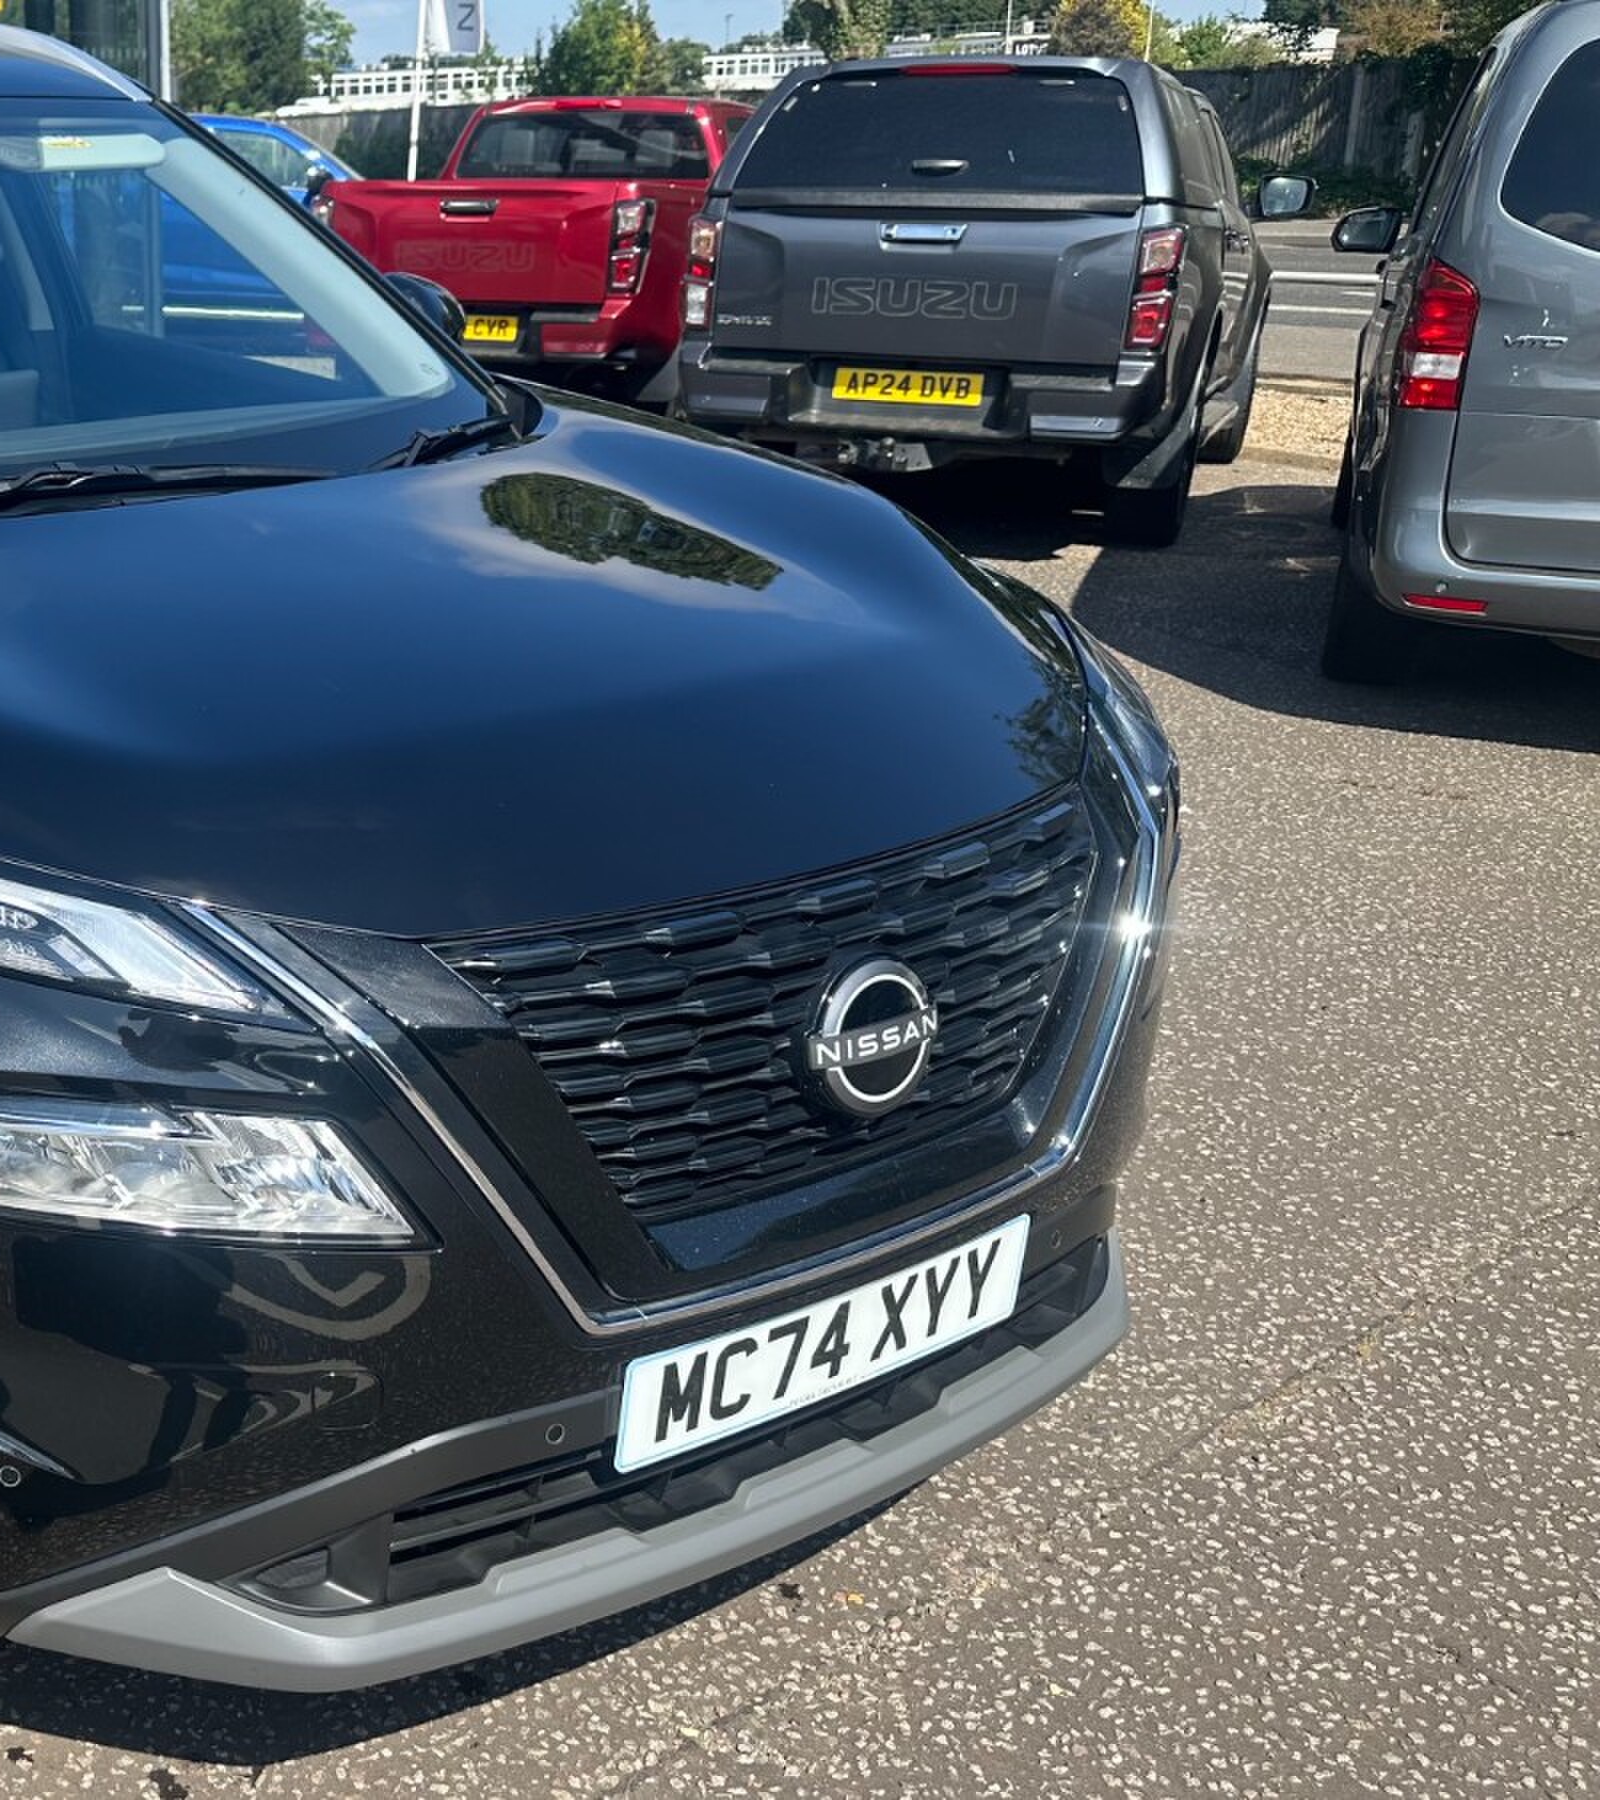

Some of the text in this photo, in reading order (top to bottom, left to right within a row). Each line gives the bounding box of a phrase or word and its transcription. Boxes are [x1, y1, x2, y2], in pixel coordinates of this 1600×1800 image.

[810, 276, 1019, 321] ISUZU
[846, 371, 971, 399] AP24 DVB
[815, 1008, 938, 1066] NISSAN
[655, 1239, 1002, 1444] MC74 XYY
